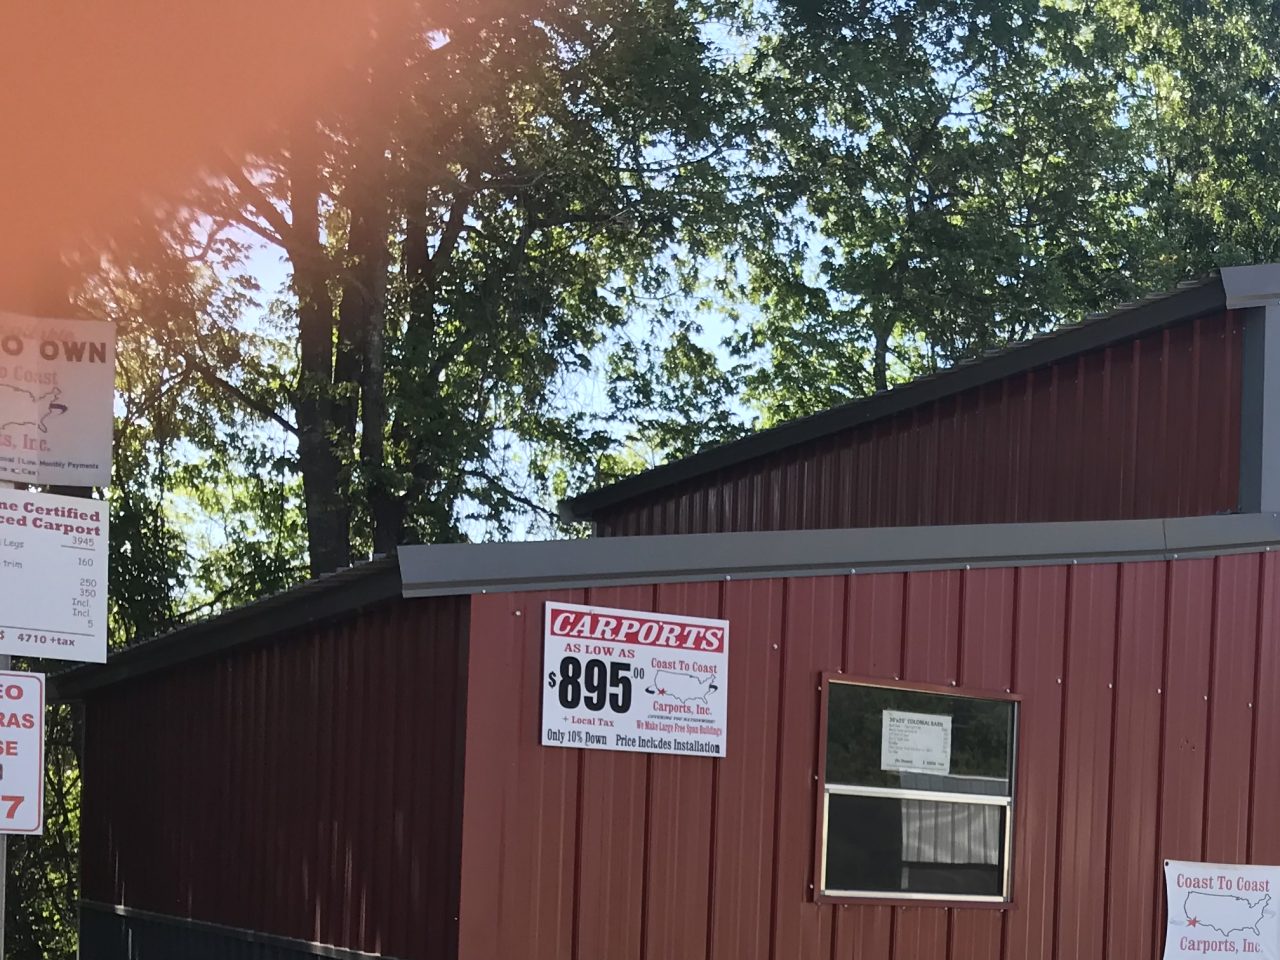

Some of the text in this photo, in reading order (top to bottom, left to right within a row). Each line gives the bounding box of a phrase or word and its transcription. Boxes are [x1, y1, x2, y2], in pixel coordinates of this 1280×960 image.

[39, 340, 107, 363] OWN
[14, 366, 58, 385] Coast
[23, 502, 101, 522] Certified
[32, 517, 100, 536] Carport
[72, 535, 95, 547] 3945
[78, 557, 94, 567] 160
[80, 578, 97, 588] 250
[80, 588, 97, 598] 350
[17, 633, 47, 644] 4710
[553, 612, 723, 651] CARPORTS
[564, 643, 636, 659] AS LOW AS
[651, 657, 718, 674] Coast To Coast
[653, 701, 712, 715] Carports, Inc.
[572, 715, 595, 726] Local
[598, 718, 615, 728] Tax
[660, 722, 674, 734] Large
[675, 723, 686, 733] Free
[547, 728, 720, 754] Only 10% Down Price Includes Installation
[1177, 873, 1270, 892] Coast To Coast
[1180, 936, 1263, 954] Carports, Inc.
